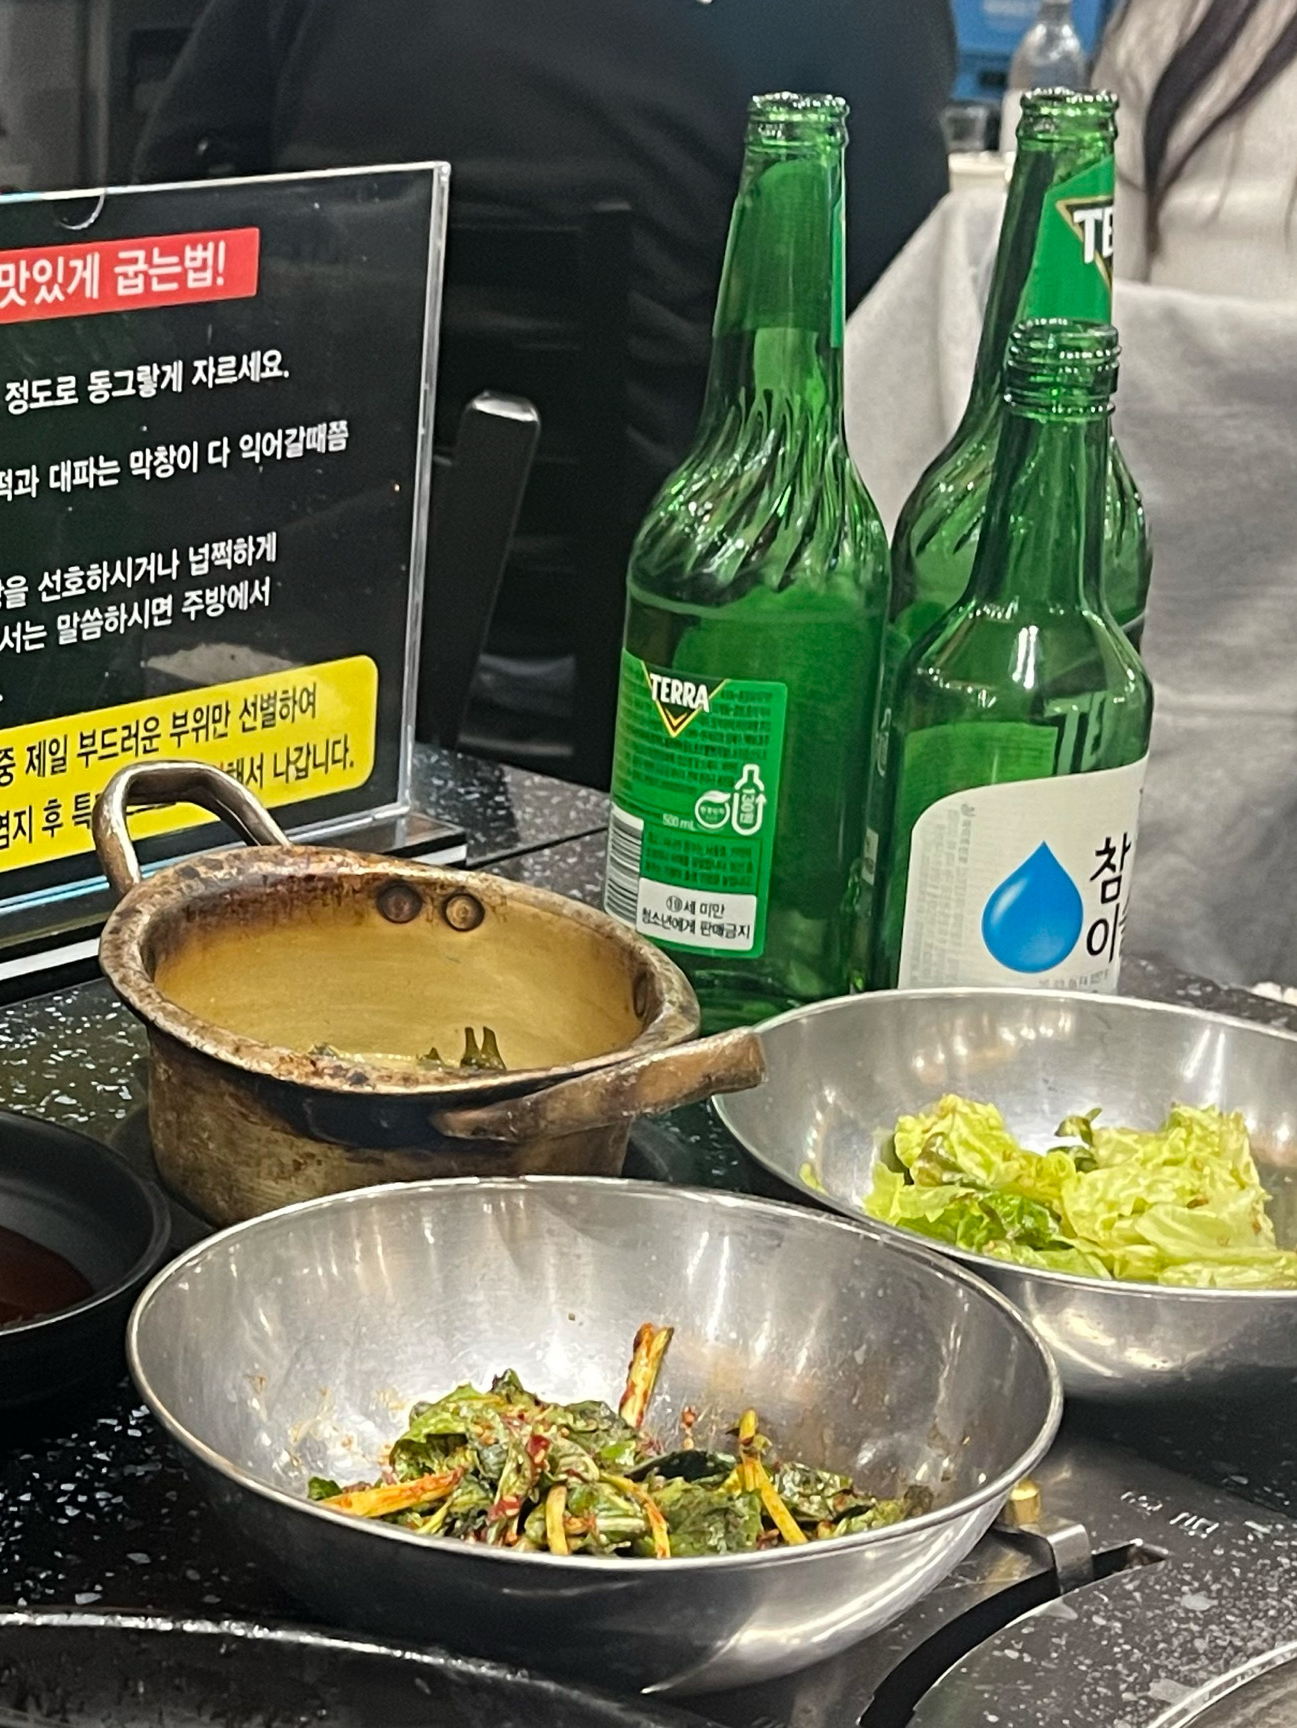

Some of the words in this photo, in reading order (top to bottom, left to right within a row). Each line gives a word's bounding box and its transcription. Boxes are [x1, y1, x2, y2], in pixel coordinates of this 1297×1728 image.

[111, 240, 227, 298] 굽는법!
[5, 376, 78, 414] 정도로
[88, 360, 183, 403] 동그랗게
[192, 350, 289, 388] 자르세요.
[50, 455, 120, 492] 대파는
[130, 441, 198, 480] 막창이
[208, 437, 230, 468] 다
[240, 420, 348, 463] 익어갈때쯤
[38, 549, 179, 604] 선호하시거나
[189, 532, 276, 576] 넙쩍하게
[55, 594, 172, 644] 말씀하시면
[182, 576, 270, 620] 주방에서
[650, 672, 710, 713] TERRA
[26, 734, 67, 777] 제일
[77, 716, 160, 774] 부드러운
[170, 704, 230, 748] 부위만
[239, 683, 316, 733] 선별하여
[42, 799, 63, 838] 후
[274, 734, 354, 784] 나갑니다.
[1090, 832, 1131, 904] 참
[700, 902, 725, 919] 미만
[701, 920, 751, 940] 판매금지
